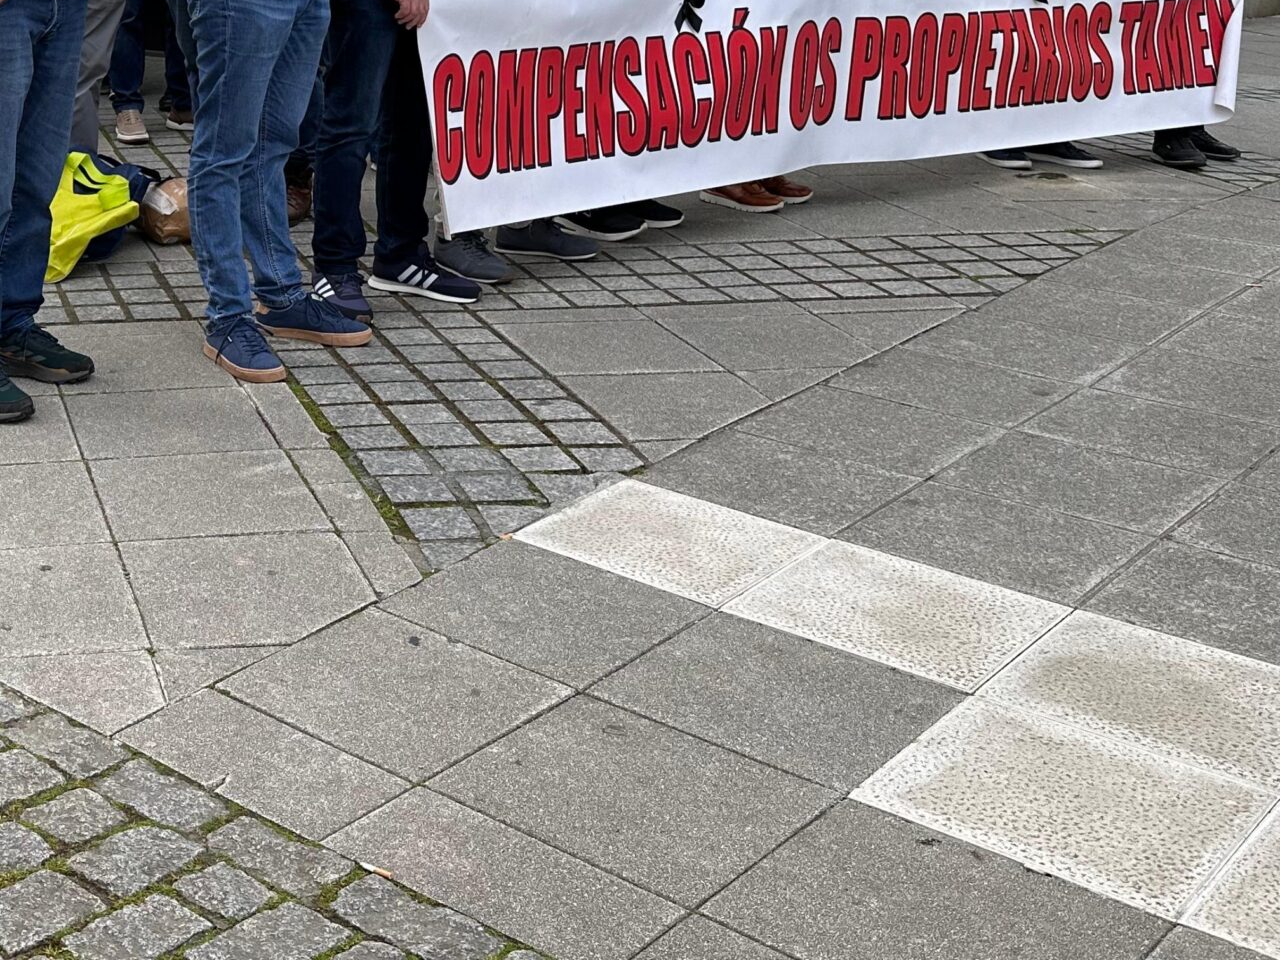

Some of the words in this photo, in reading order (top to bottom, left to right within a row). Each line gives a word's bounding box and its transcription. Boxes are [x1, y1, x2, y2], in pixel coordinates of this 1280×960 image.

[433, 7, 788, 185] COMPENSACIÓN
[789, 16, 841, 131] OS
[844, 1, 1114, 121] PROPIETARIOS
